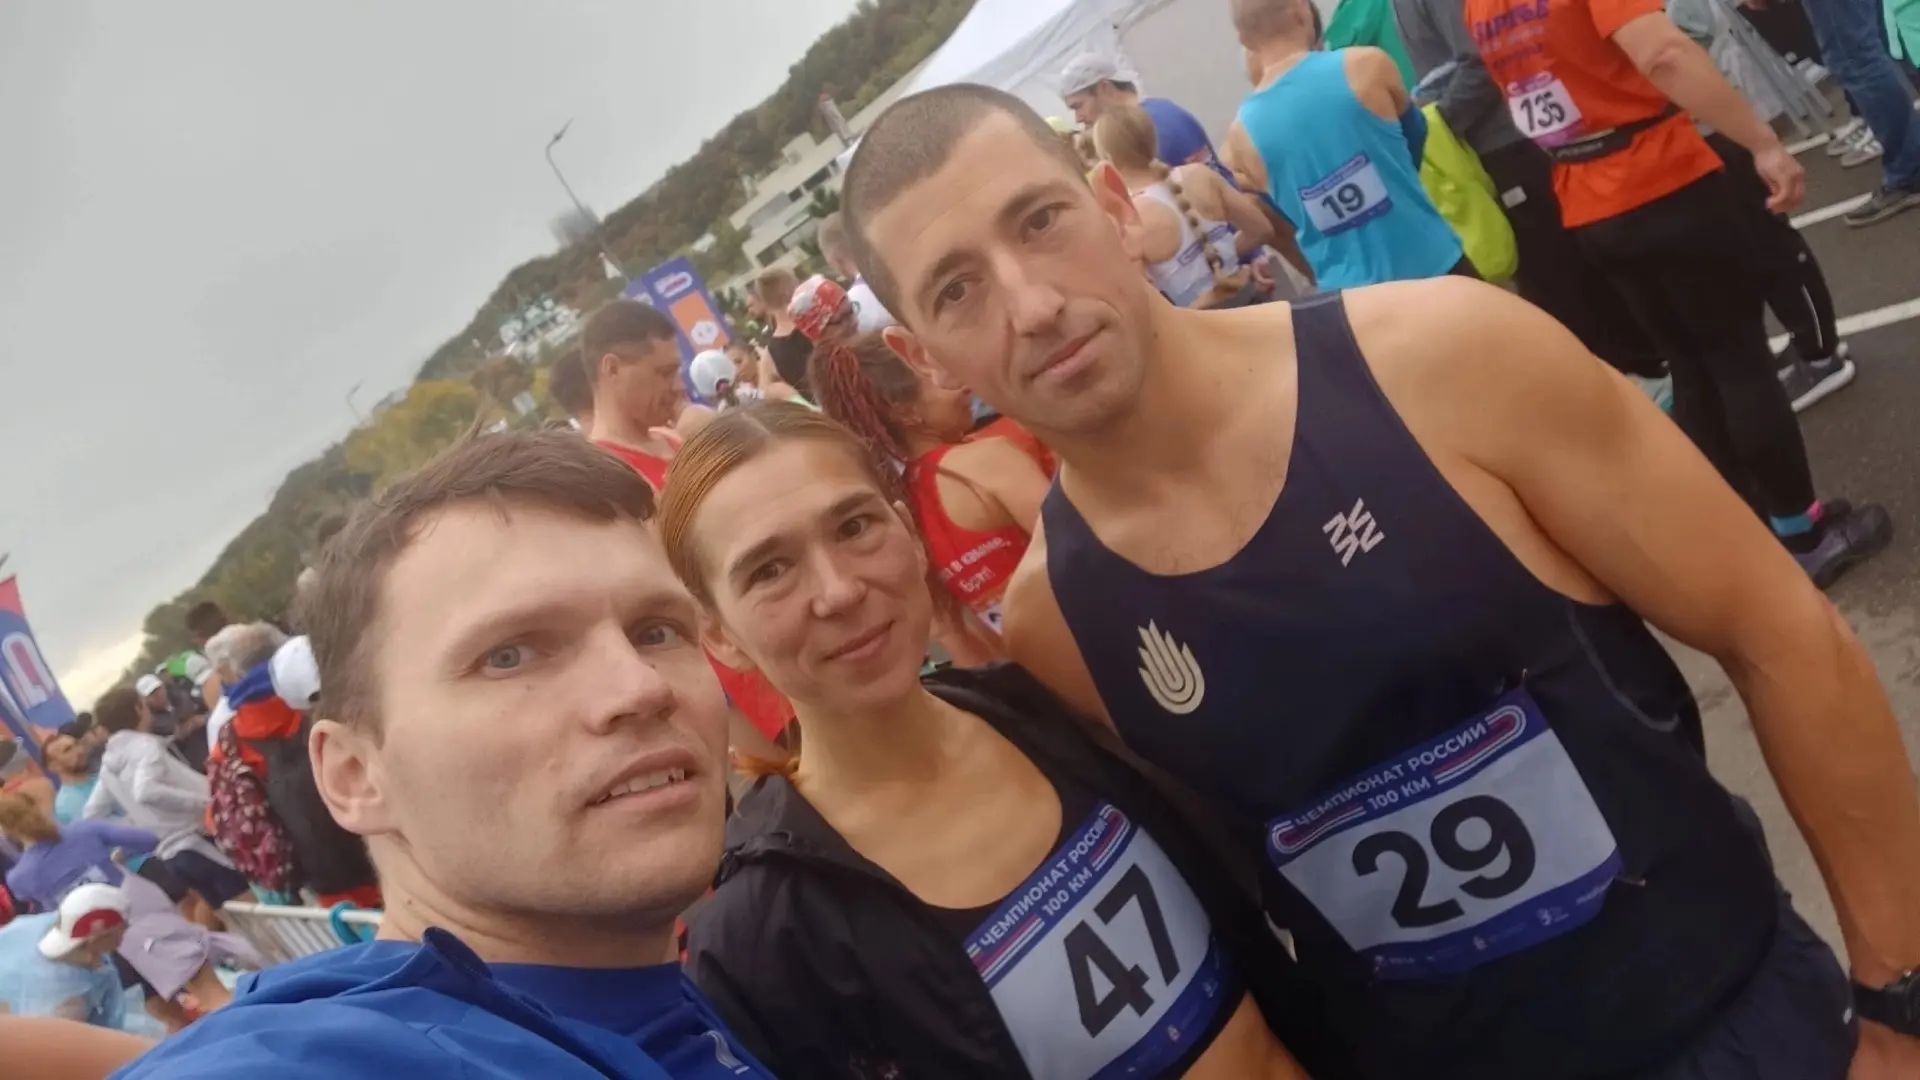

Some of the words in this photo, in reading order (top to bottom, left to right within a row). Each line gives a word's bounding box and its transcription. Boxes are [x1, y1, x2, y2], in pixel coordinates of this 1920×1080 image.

[1520, 92, 1565, 132] 135
[1321, 182, 1365, 220] 19
[1295, 764, 1404, 827] ЧЕМПИОНАТ
[1407, 721, 1487, 771] РОССИИ
[1367, 790, 1399, 811] 100
[1402, 775, 1431, 799] КМ
[1042, 888, 1070, 916] 100
[1067, 867, 1093, 895] КМ
[1352, 795, 1535, 928] 29
[980, 858, 1070, 949] ЧЕМПИОНАТ
[1063, 862, 1181, 1039] 47
